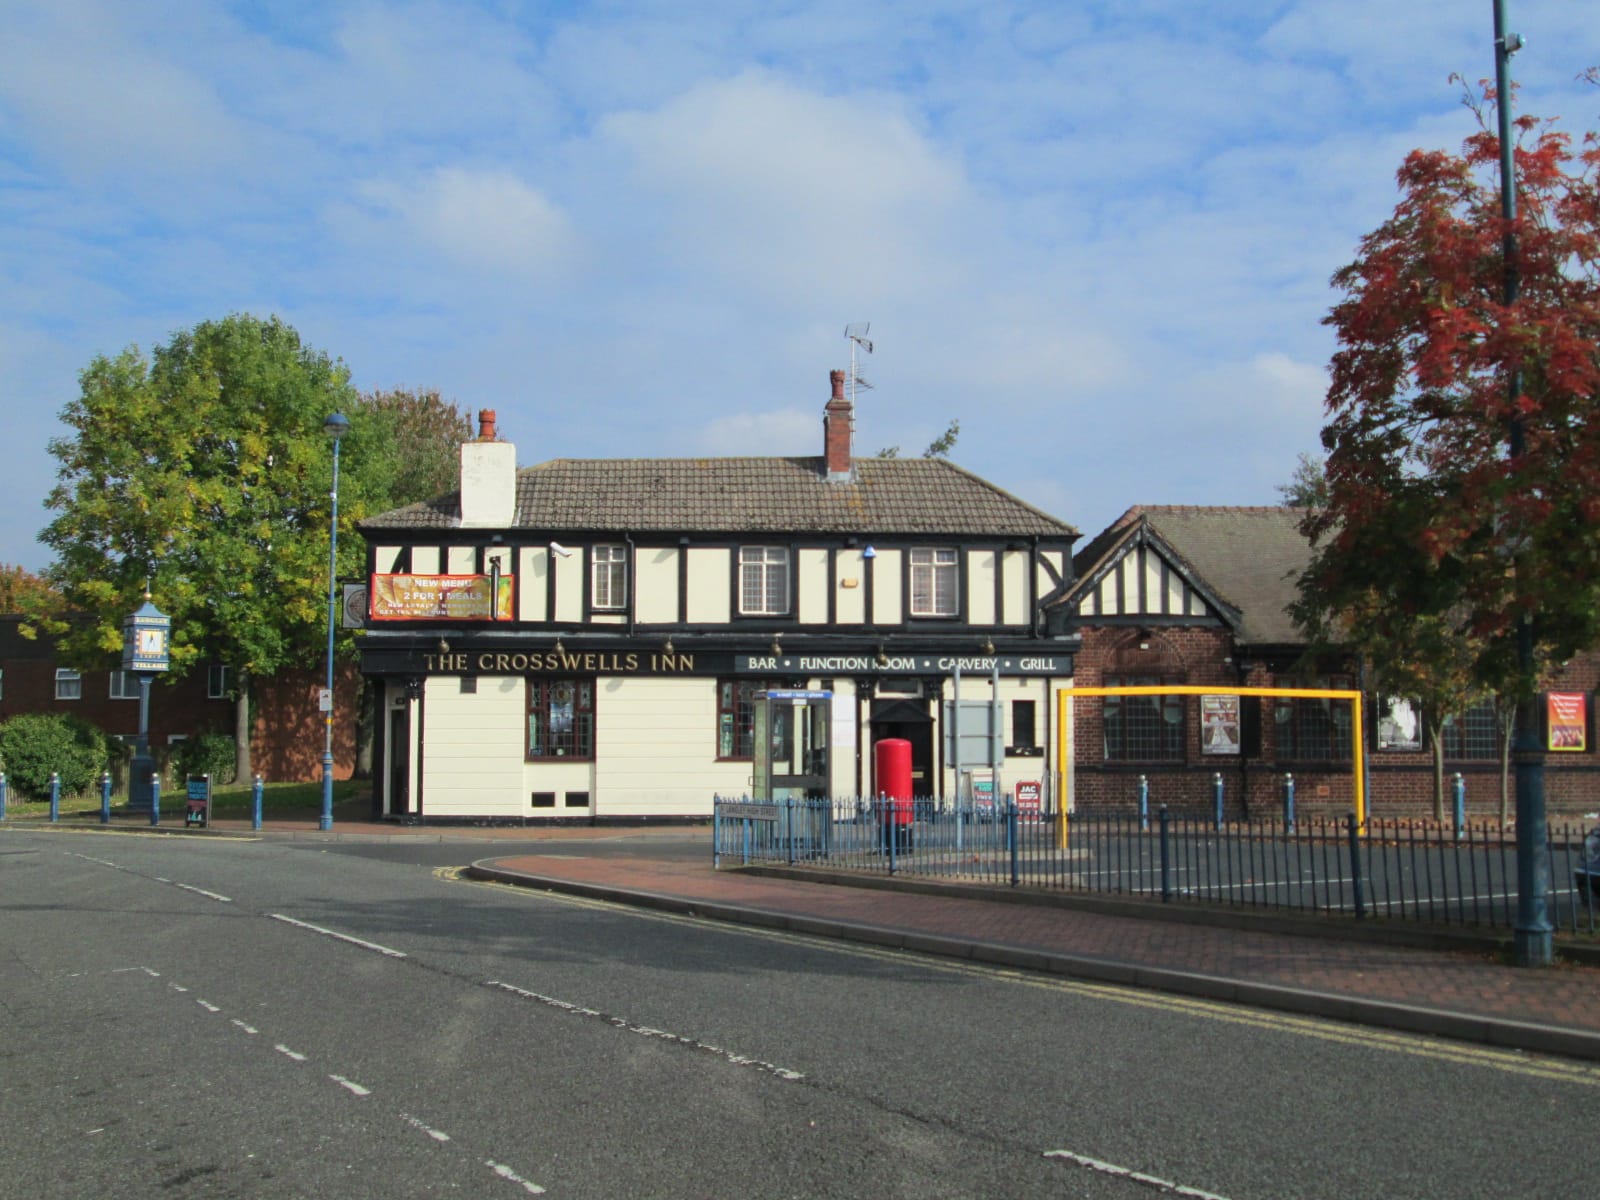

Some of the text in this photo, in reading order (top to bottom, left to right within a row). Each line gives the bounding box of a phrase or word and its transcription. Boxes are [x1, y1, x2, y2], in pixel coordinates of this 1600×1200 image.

[415, 579, 472, 587] NEW MENU
[403, 592, 482, 600] 2 FOR 1 MEALS
[424, 653, 695, 671] THE CROSSWELLS INN
[748, 657, 778, 669] BAR
[799, 657, 868, 670] FUNCTION
[938, 657, 998, 670] CARVERY
[1020, 658, 1057, 670] GRILL
